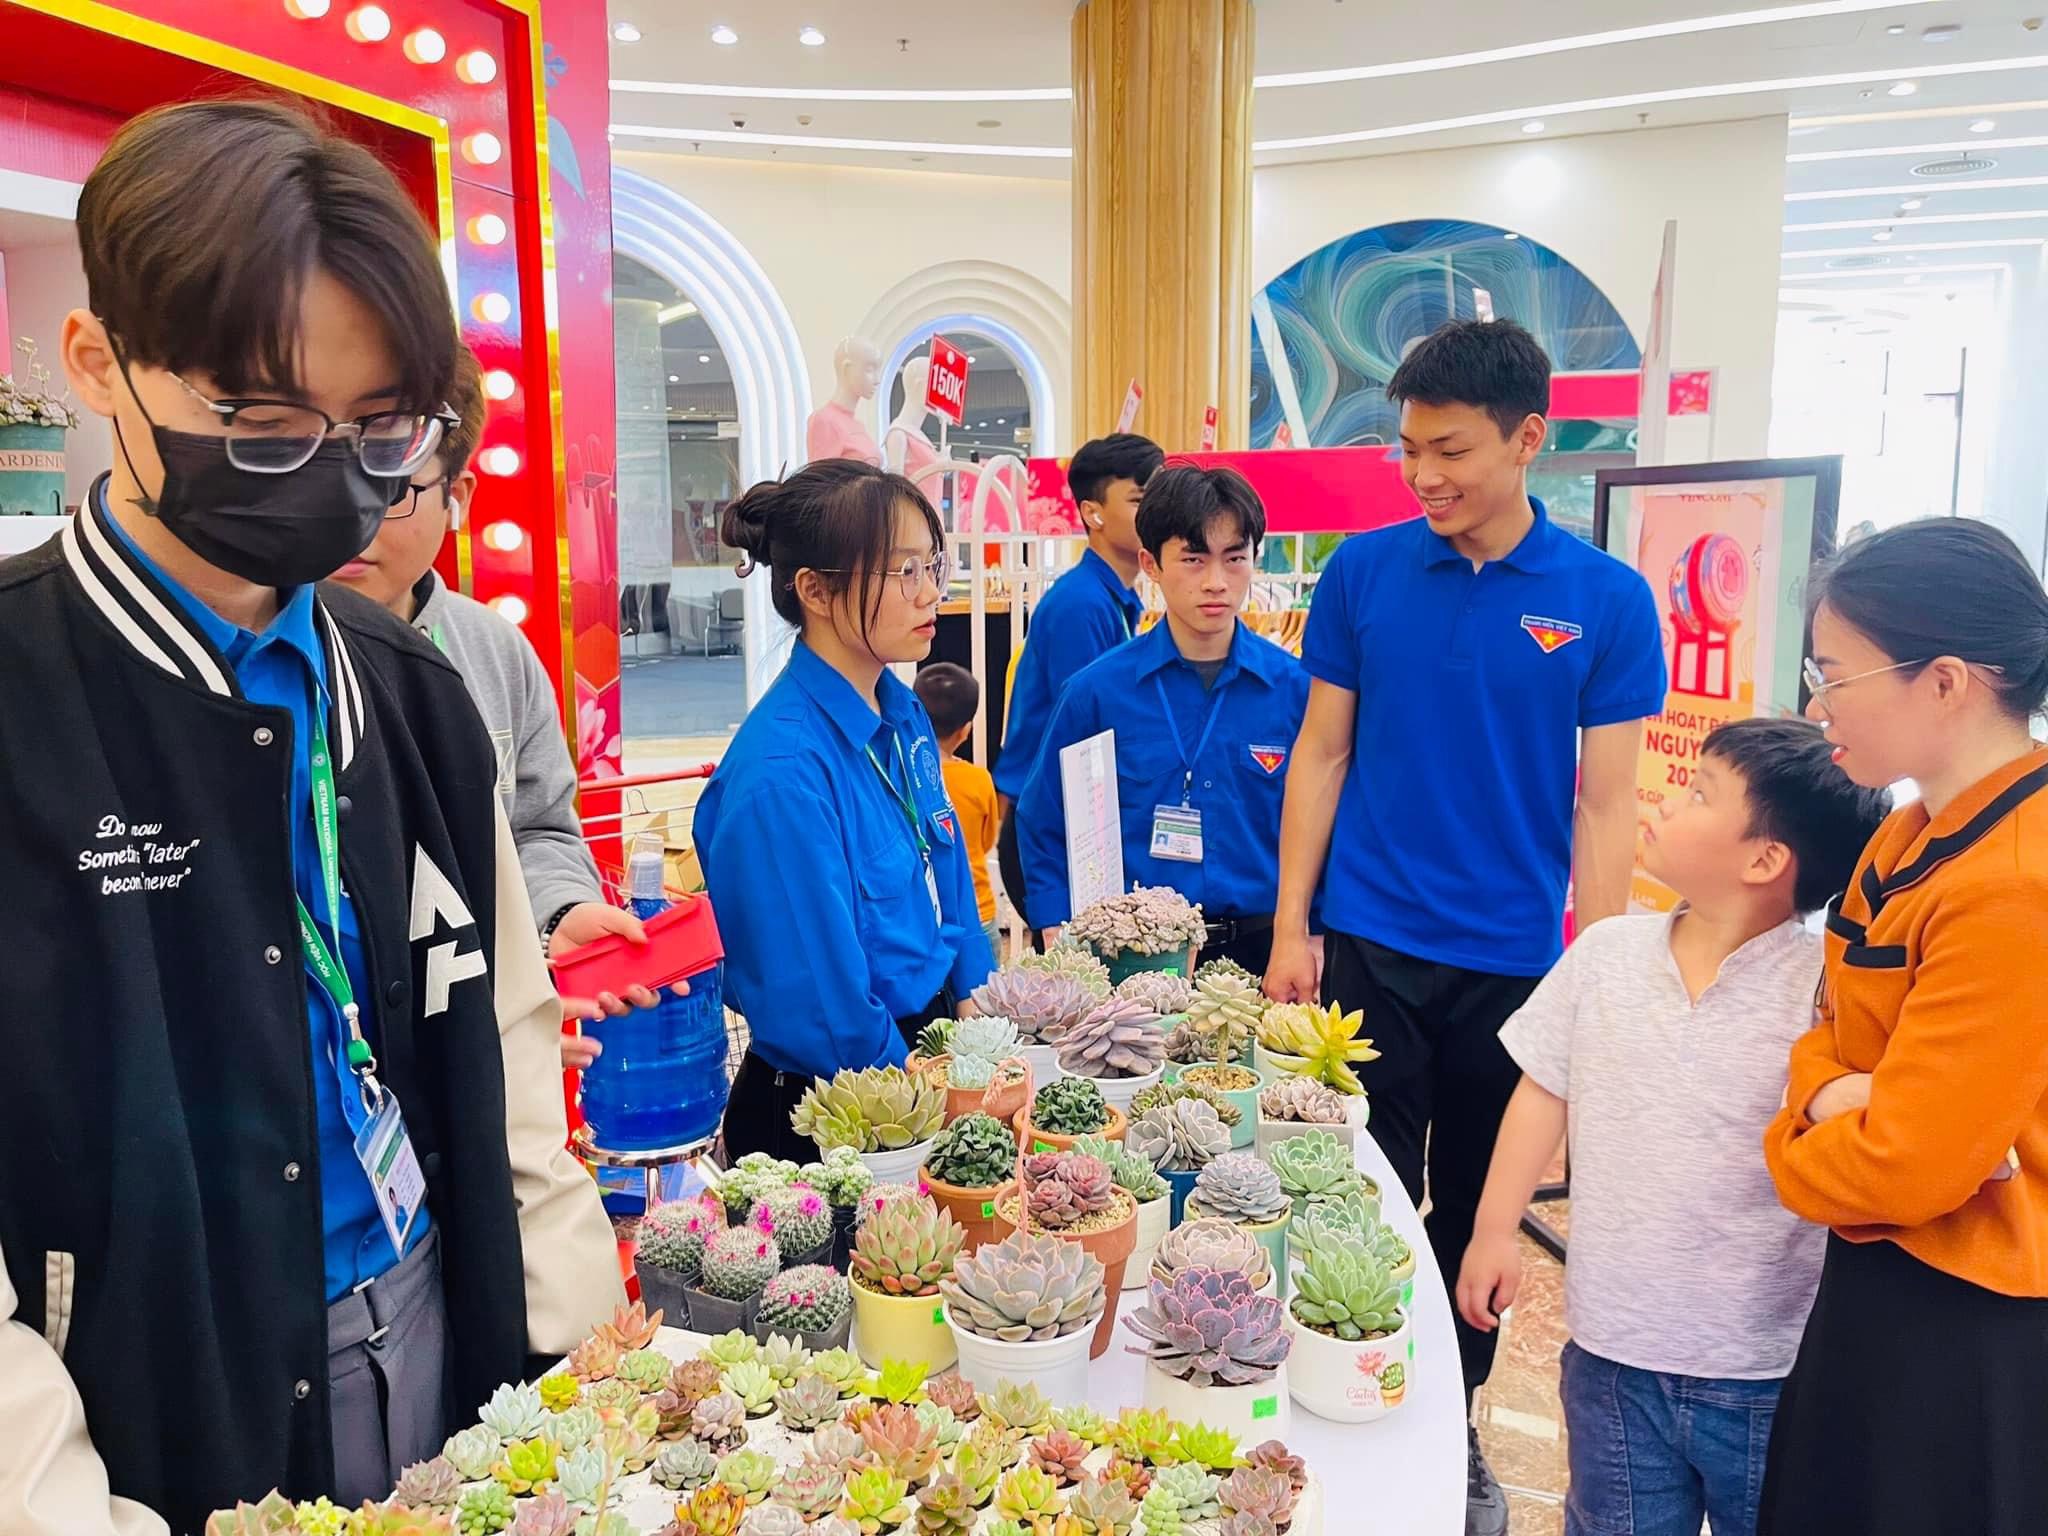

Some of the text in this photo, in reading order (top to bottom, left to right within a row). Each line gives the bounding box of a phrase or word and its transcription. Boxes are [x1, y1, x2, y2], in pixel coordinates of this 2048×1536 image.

[932, 363, 963, 407] 150K
[1647, 730, 1701, 761] NGUY
[96, 814, 162, 839] Do now
